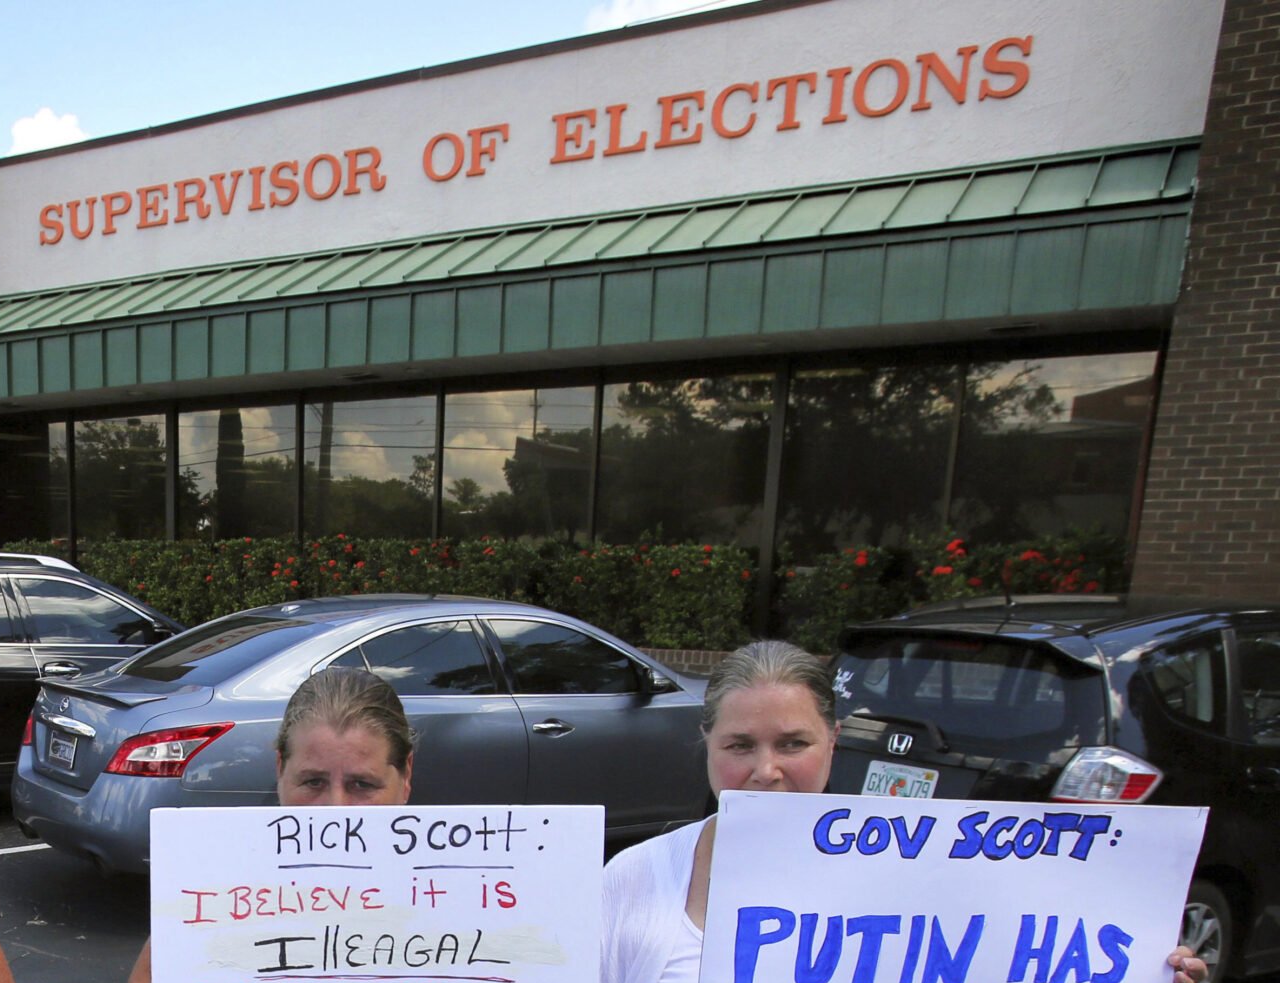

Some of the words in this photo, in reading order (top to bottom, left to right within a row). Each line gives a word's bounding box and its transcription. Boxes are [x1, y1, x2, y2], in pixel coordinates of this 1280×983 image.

[39, 145, 387, 246] SUPERVISOR
[422, 122, 510, 183] OF
[549, 34, 1034, 165] ELECTIONS
[813, 808, 937, 859] GOV
[948, 811, 1123, 861] SCOTT:
[181, 890, 218, 923] I
